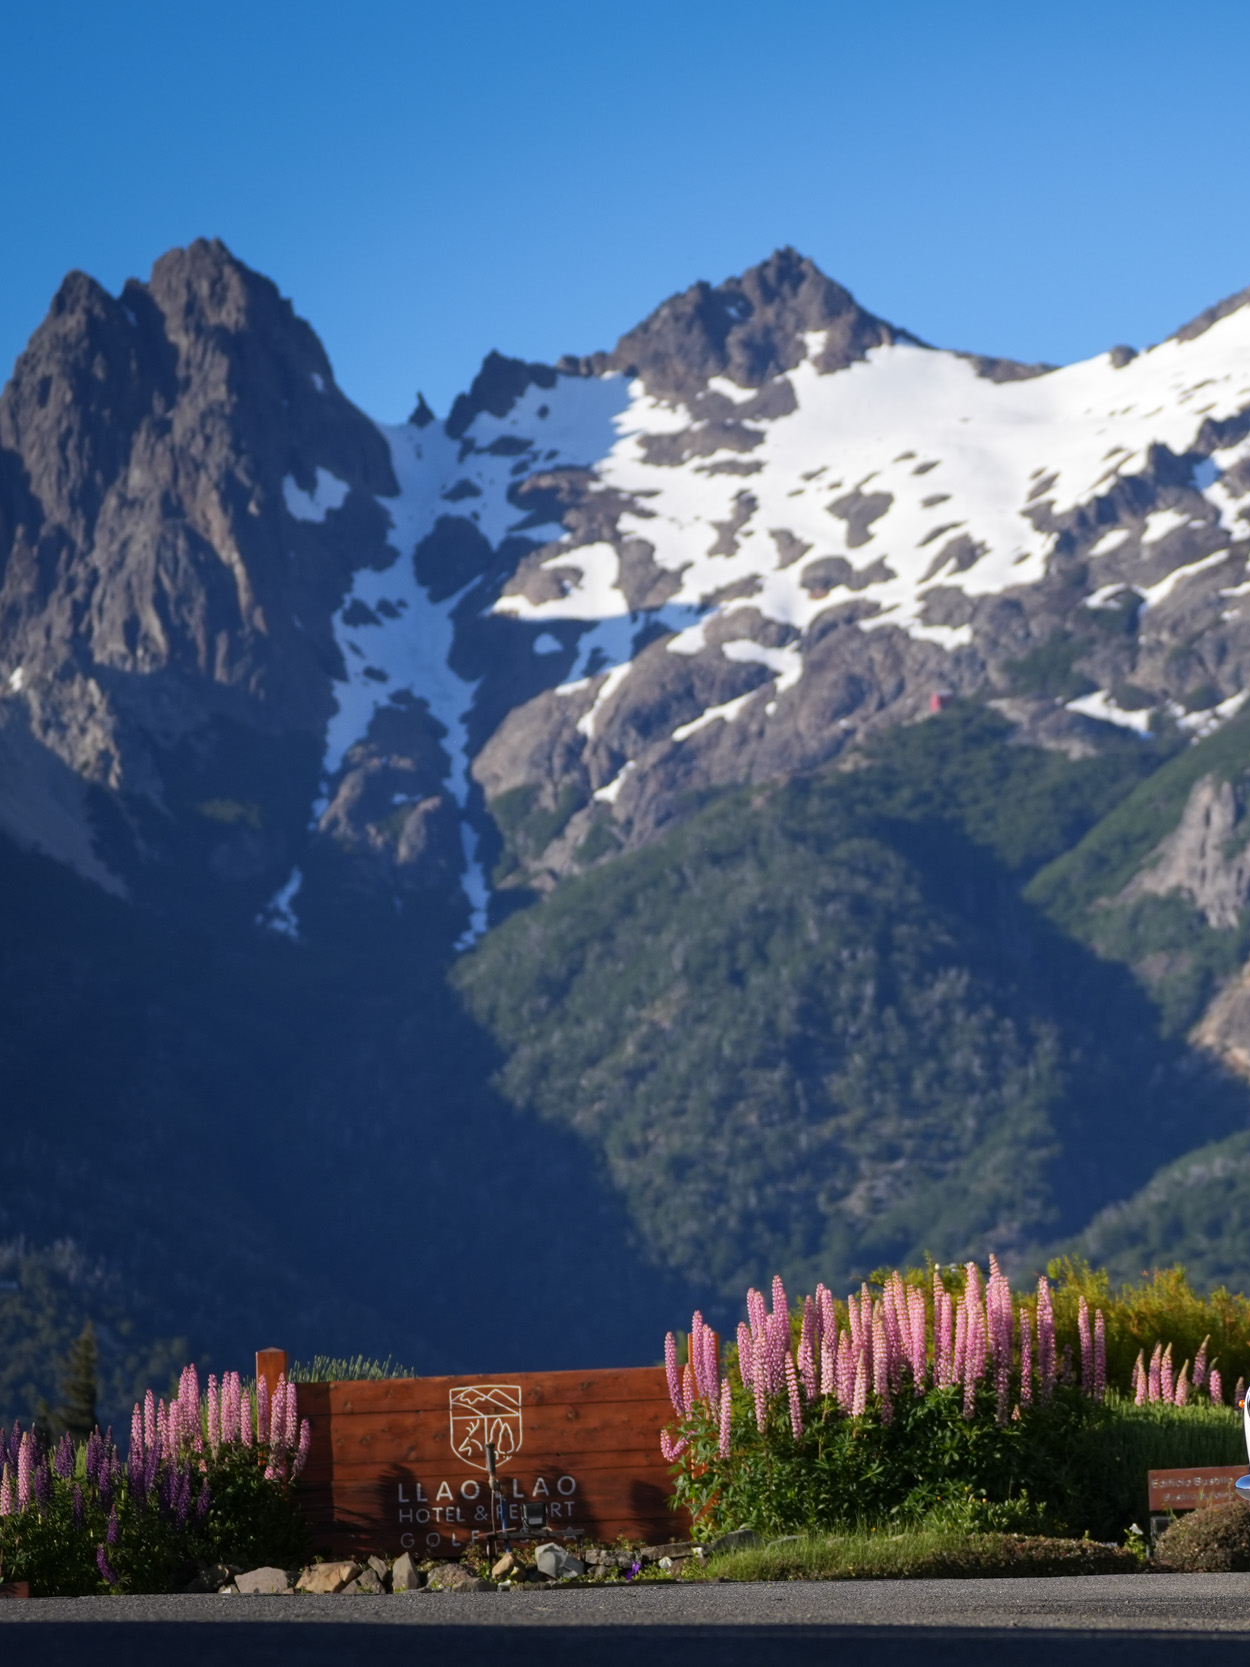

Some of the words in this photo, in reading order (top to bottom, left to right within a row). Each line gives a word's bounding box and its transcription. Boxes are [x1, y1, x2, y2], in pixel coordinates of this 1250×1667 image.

[398, 1480, 480, 1502] LLAO
[495, 1476, 576, 1499] LAO
[399, 1506, 466, 1524] HOTEL
[474, 1505, 488, 1521] &
[400, 1530, 480, 1548] GOLF
